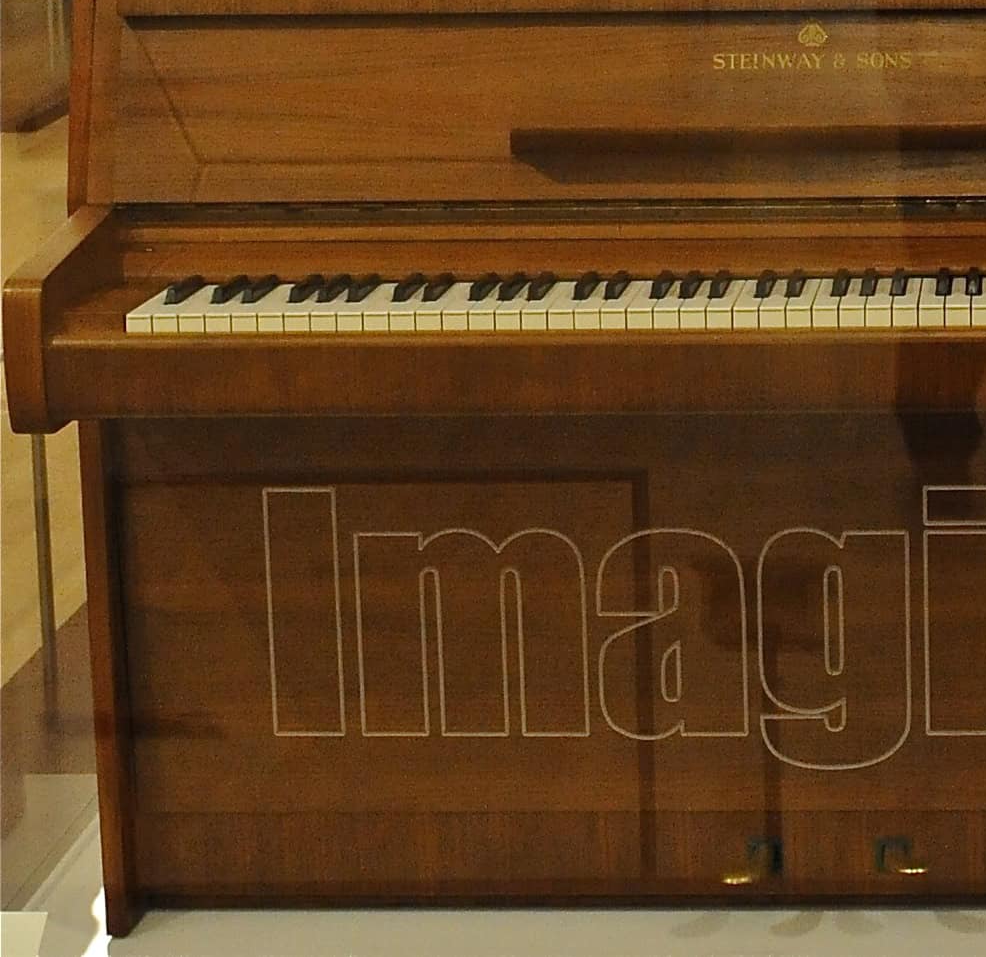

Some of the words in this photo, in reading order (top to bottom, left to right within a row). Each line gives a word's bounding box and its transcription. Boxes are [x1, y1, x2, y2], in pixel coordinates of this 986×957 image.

[712, 52, 825, 71] STEINWAY
[832, 52, 846, 70] &
[856, 51, 914, 70] SONS
